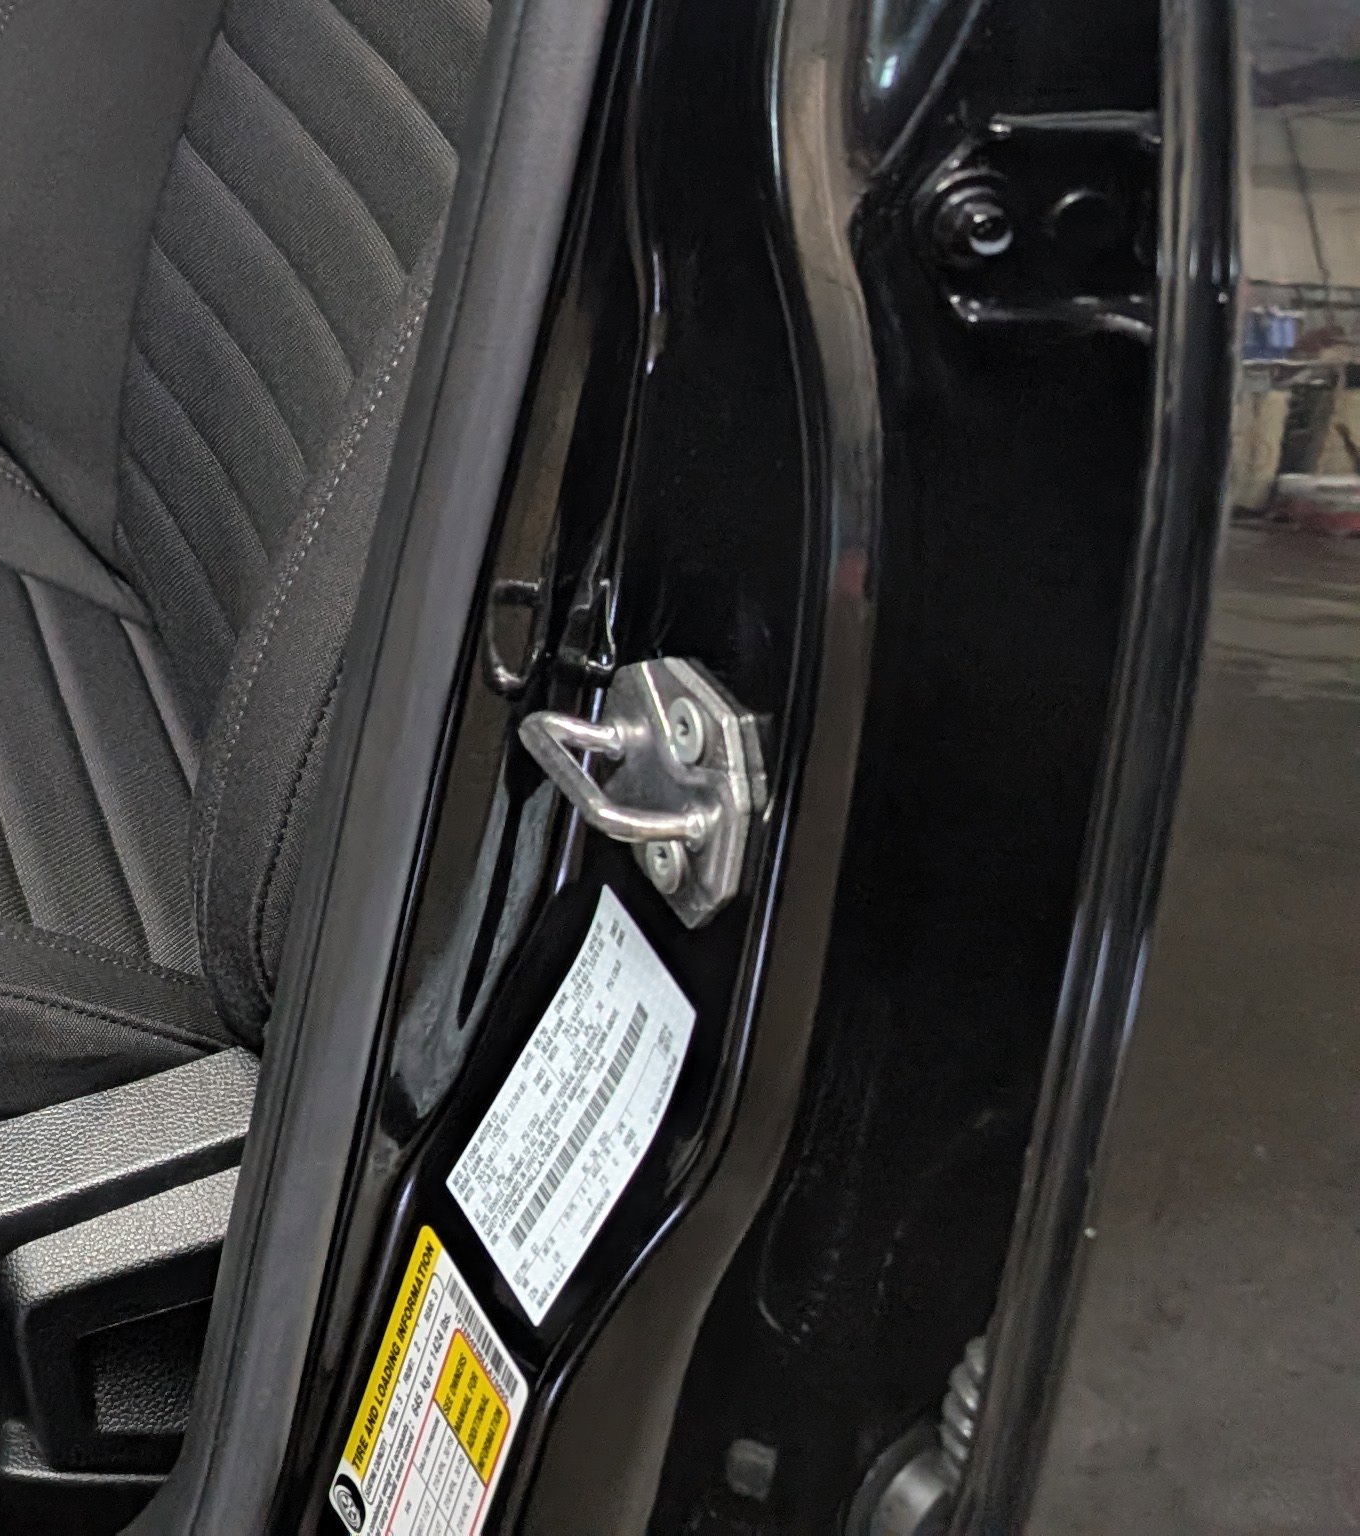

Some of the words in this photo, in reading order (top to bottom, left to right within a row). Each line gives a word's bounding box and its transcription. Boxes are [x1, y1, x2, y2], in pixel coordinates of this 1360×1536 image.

[413, 1341, 421, 1353] 2
[431, 1289, 438, 1300] 3
[351, 1435, 368, 1470] TIRE
[364, 1405, 378, 1438] AND
[374, 1341, 401, 1407] LOADING
[396, 1242, 434, 1343] INFORMATION
[411, 1391, 423, 1417] 645
[420, 1375, 431, 1392] kg
[427, 1361, 433, 1376] or
[430, 1329, 444, 1360] 1424
[443, 1393, 454, 1416] SEE
[454, 1395, 472, 1435] MANUAL
[468, 1371, 478, 1394] FOR
[466, 1395, 489, 1450] ADDITIONAL
[478, 1407, 503, 1472] INFORMATION
